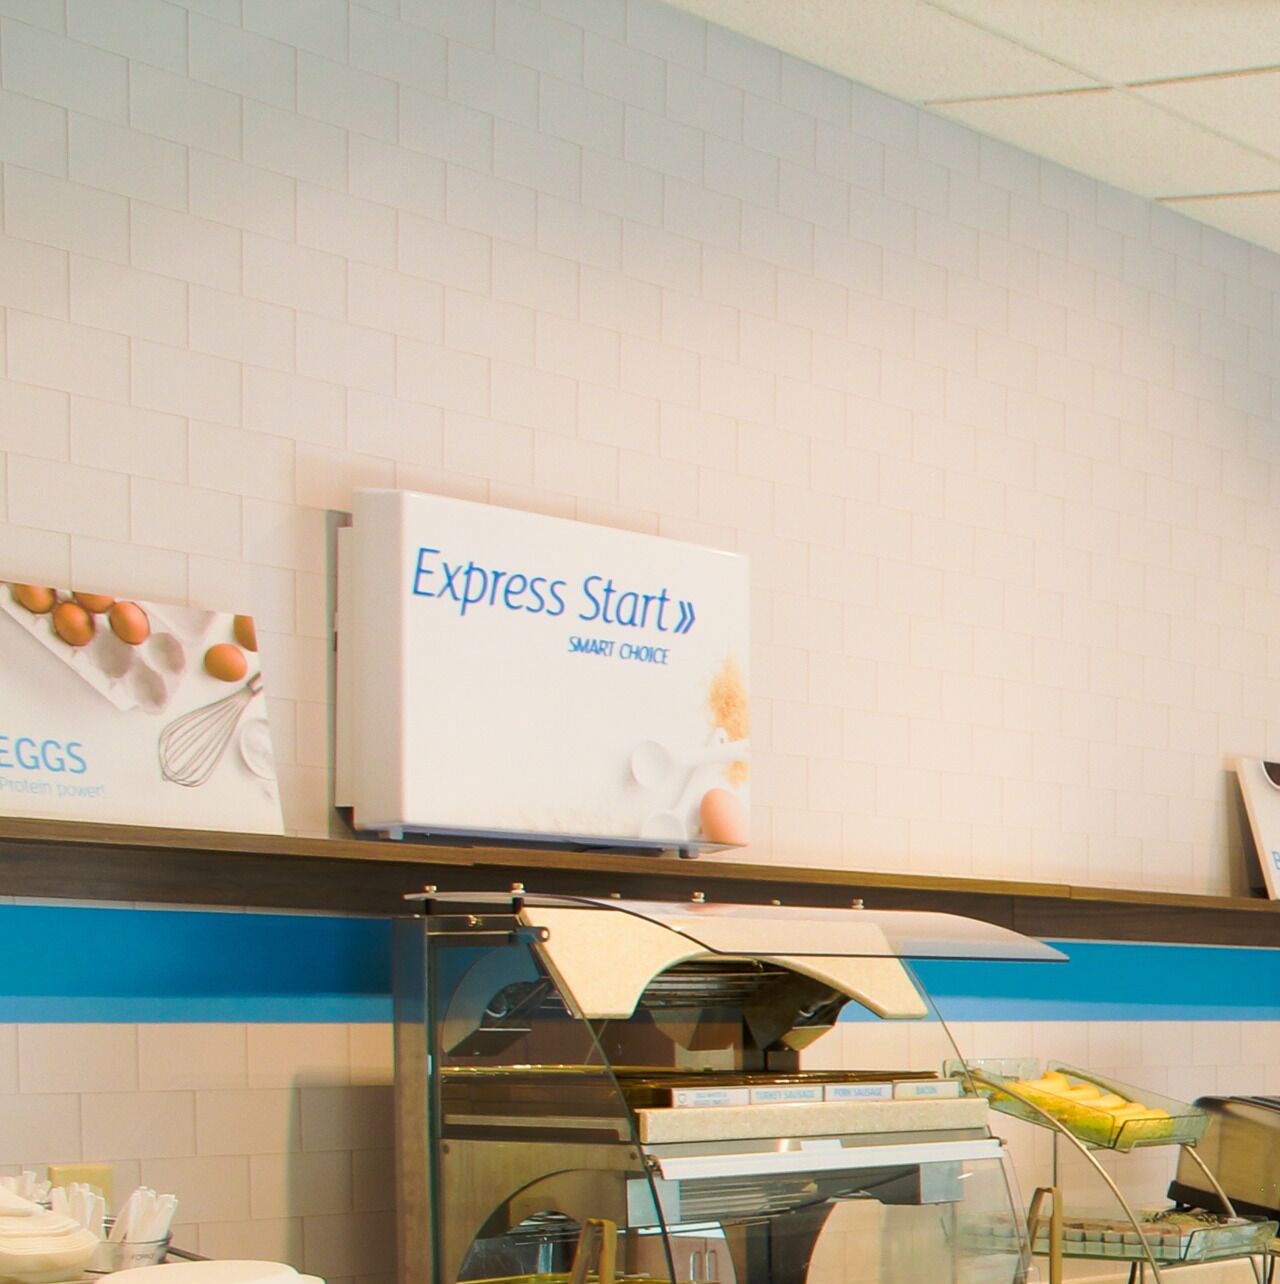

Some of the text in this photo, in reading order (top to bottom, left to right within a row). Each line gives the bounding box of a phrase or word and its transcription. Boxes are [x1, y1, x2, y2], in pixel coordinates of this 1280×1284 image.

[412, 547, 567, 617] Express
[568, 636, 671, 665] SMART CHOICE
